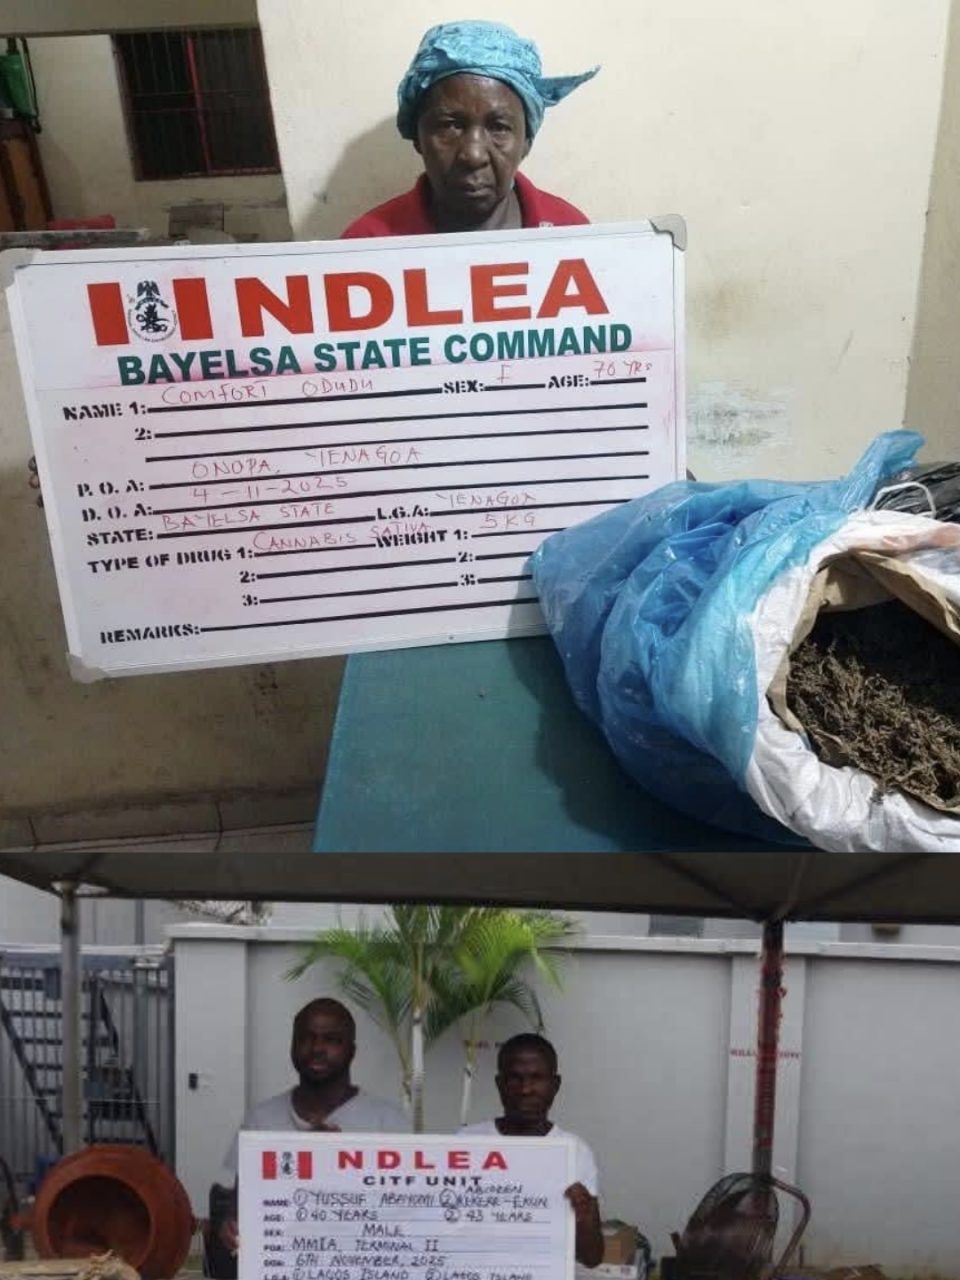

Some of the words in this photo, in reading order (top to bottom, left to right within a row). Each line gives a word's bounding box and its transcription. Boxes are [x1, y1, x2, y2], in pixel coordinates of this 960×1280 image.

[235, 258, 610, 338] NDLEA
[117, 345, 302, 386] BAYELSA
[314, 337, 431, 372] STATE
[444, 323, 632, 364] COMMAND
[443, 379, 486, 394] SEX:
[548, 374, 591, 389] AGE:
[87, 527, 155, 546] STATE:
[280, 502, 335, 519] STATE
[87, 556, 139, 574] TYPE
[145, 553, 170, 568] OF
[100, 622, 200, 644] REMARKS:
[338, 1151, 508, 1169] NDLEA
[363, 1175, 416, 1186] CITF
[426, 1175, 482, 1186] UNIT
